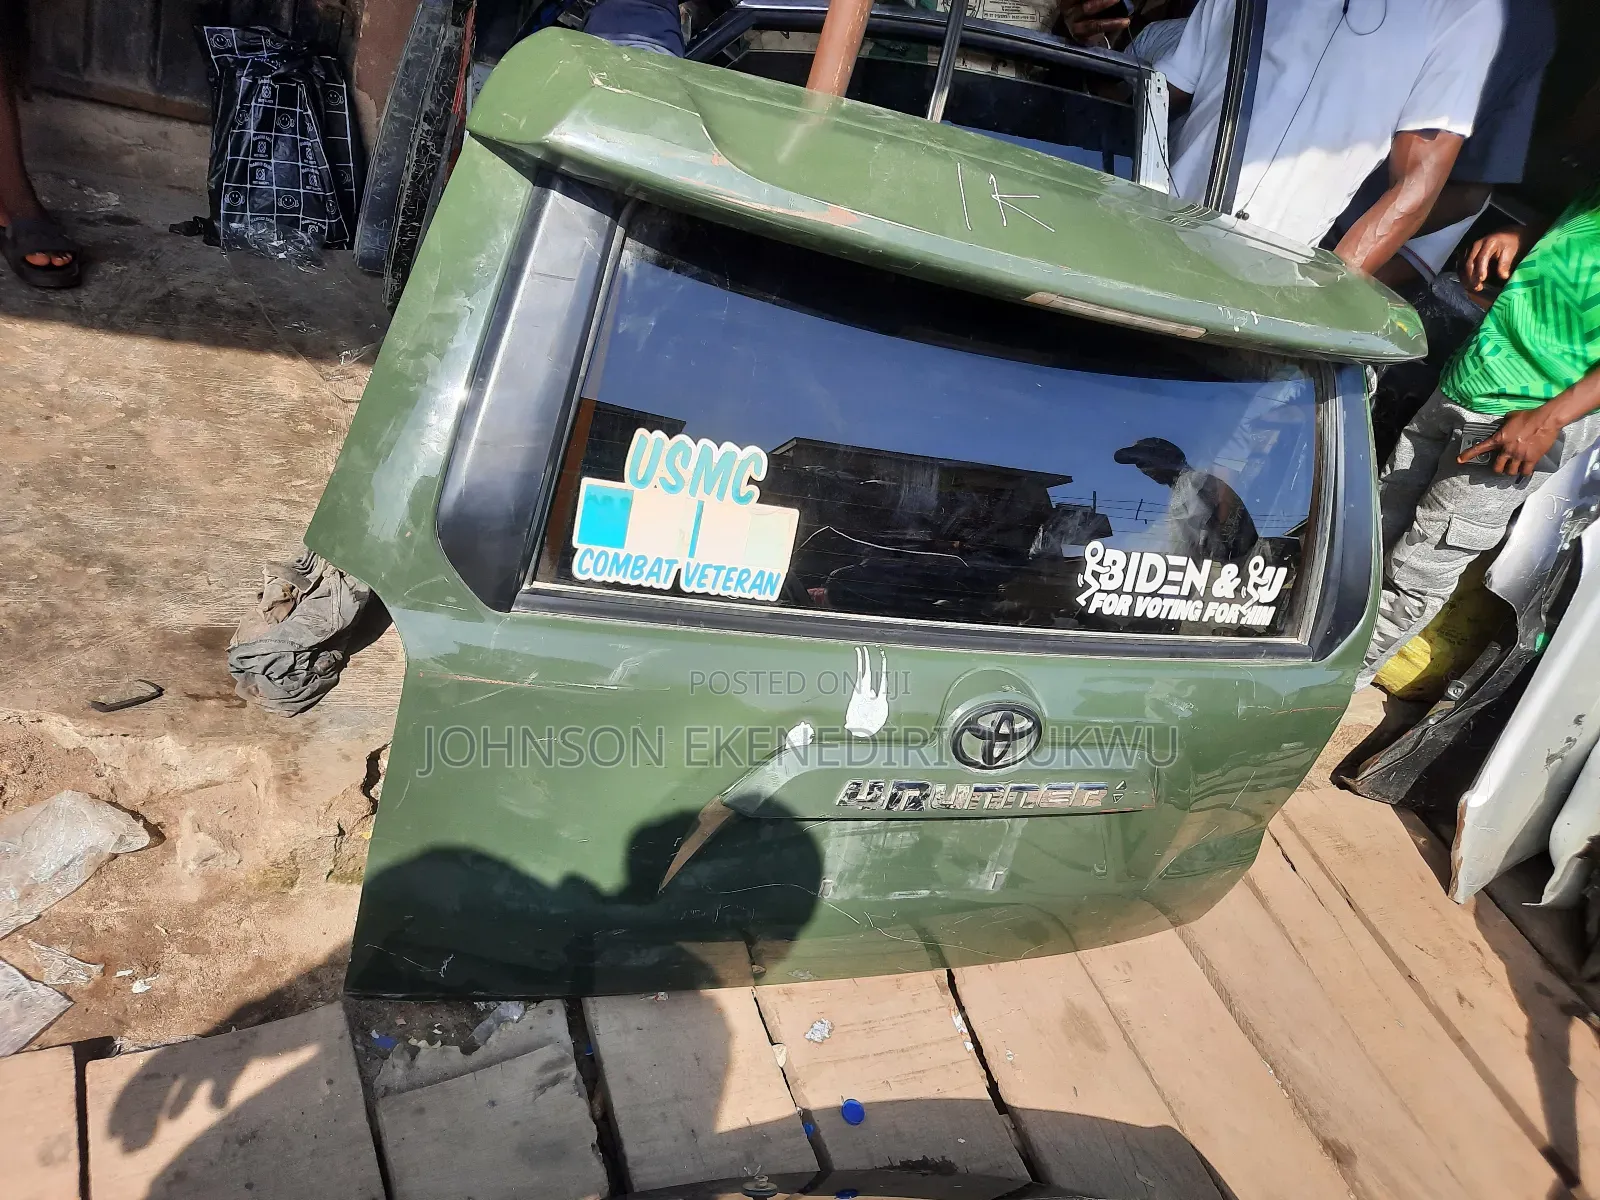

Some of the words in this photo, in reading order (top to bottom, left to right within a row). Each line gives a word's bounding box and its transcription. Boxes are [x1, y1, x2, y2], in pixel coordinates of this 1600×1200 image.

[630, 434, 763, 504] USMC
[577, 548, 678, 584] COMBAT
[684, 561, 781, 596] VETERAN
[1100, 548, 1213, 597] BIDEN
[1088, 592, 1132, 616] FOR
[1133, 596, 1202, 622] VOTING
[1201, 601, 1243, 624] FOR
